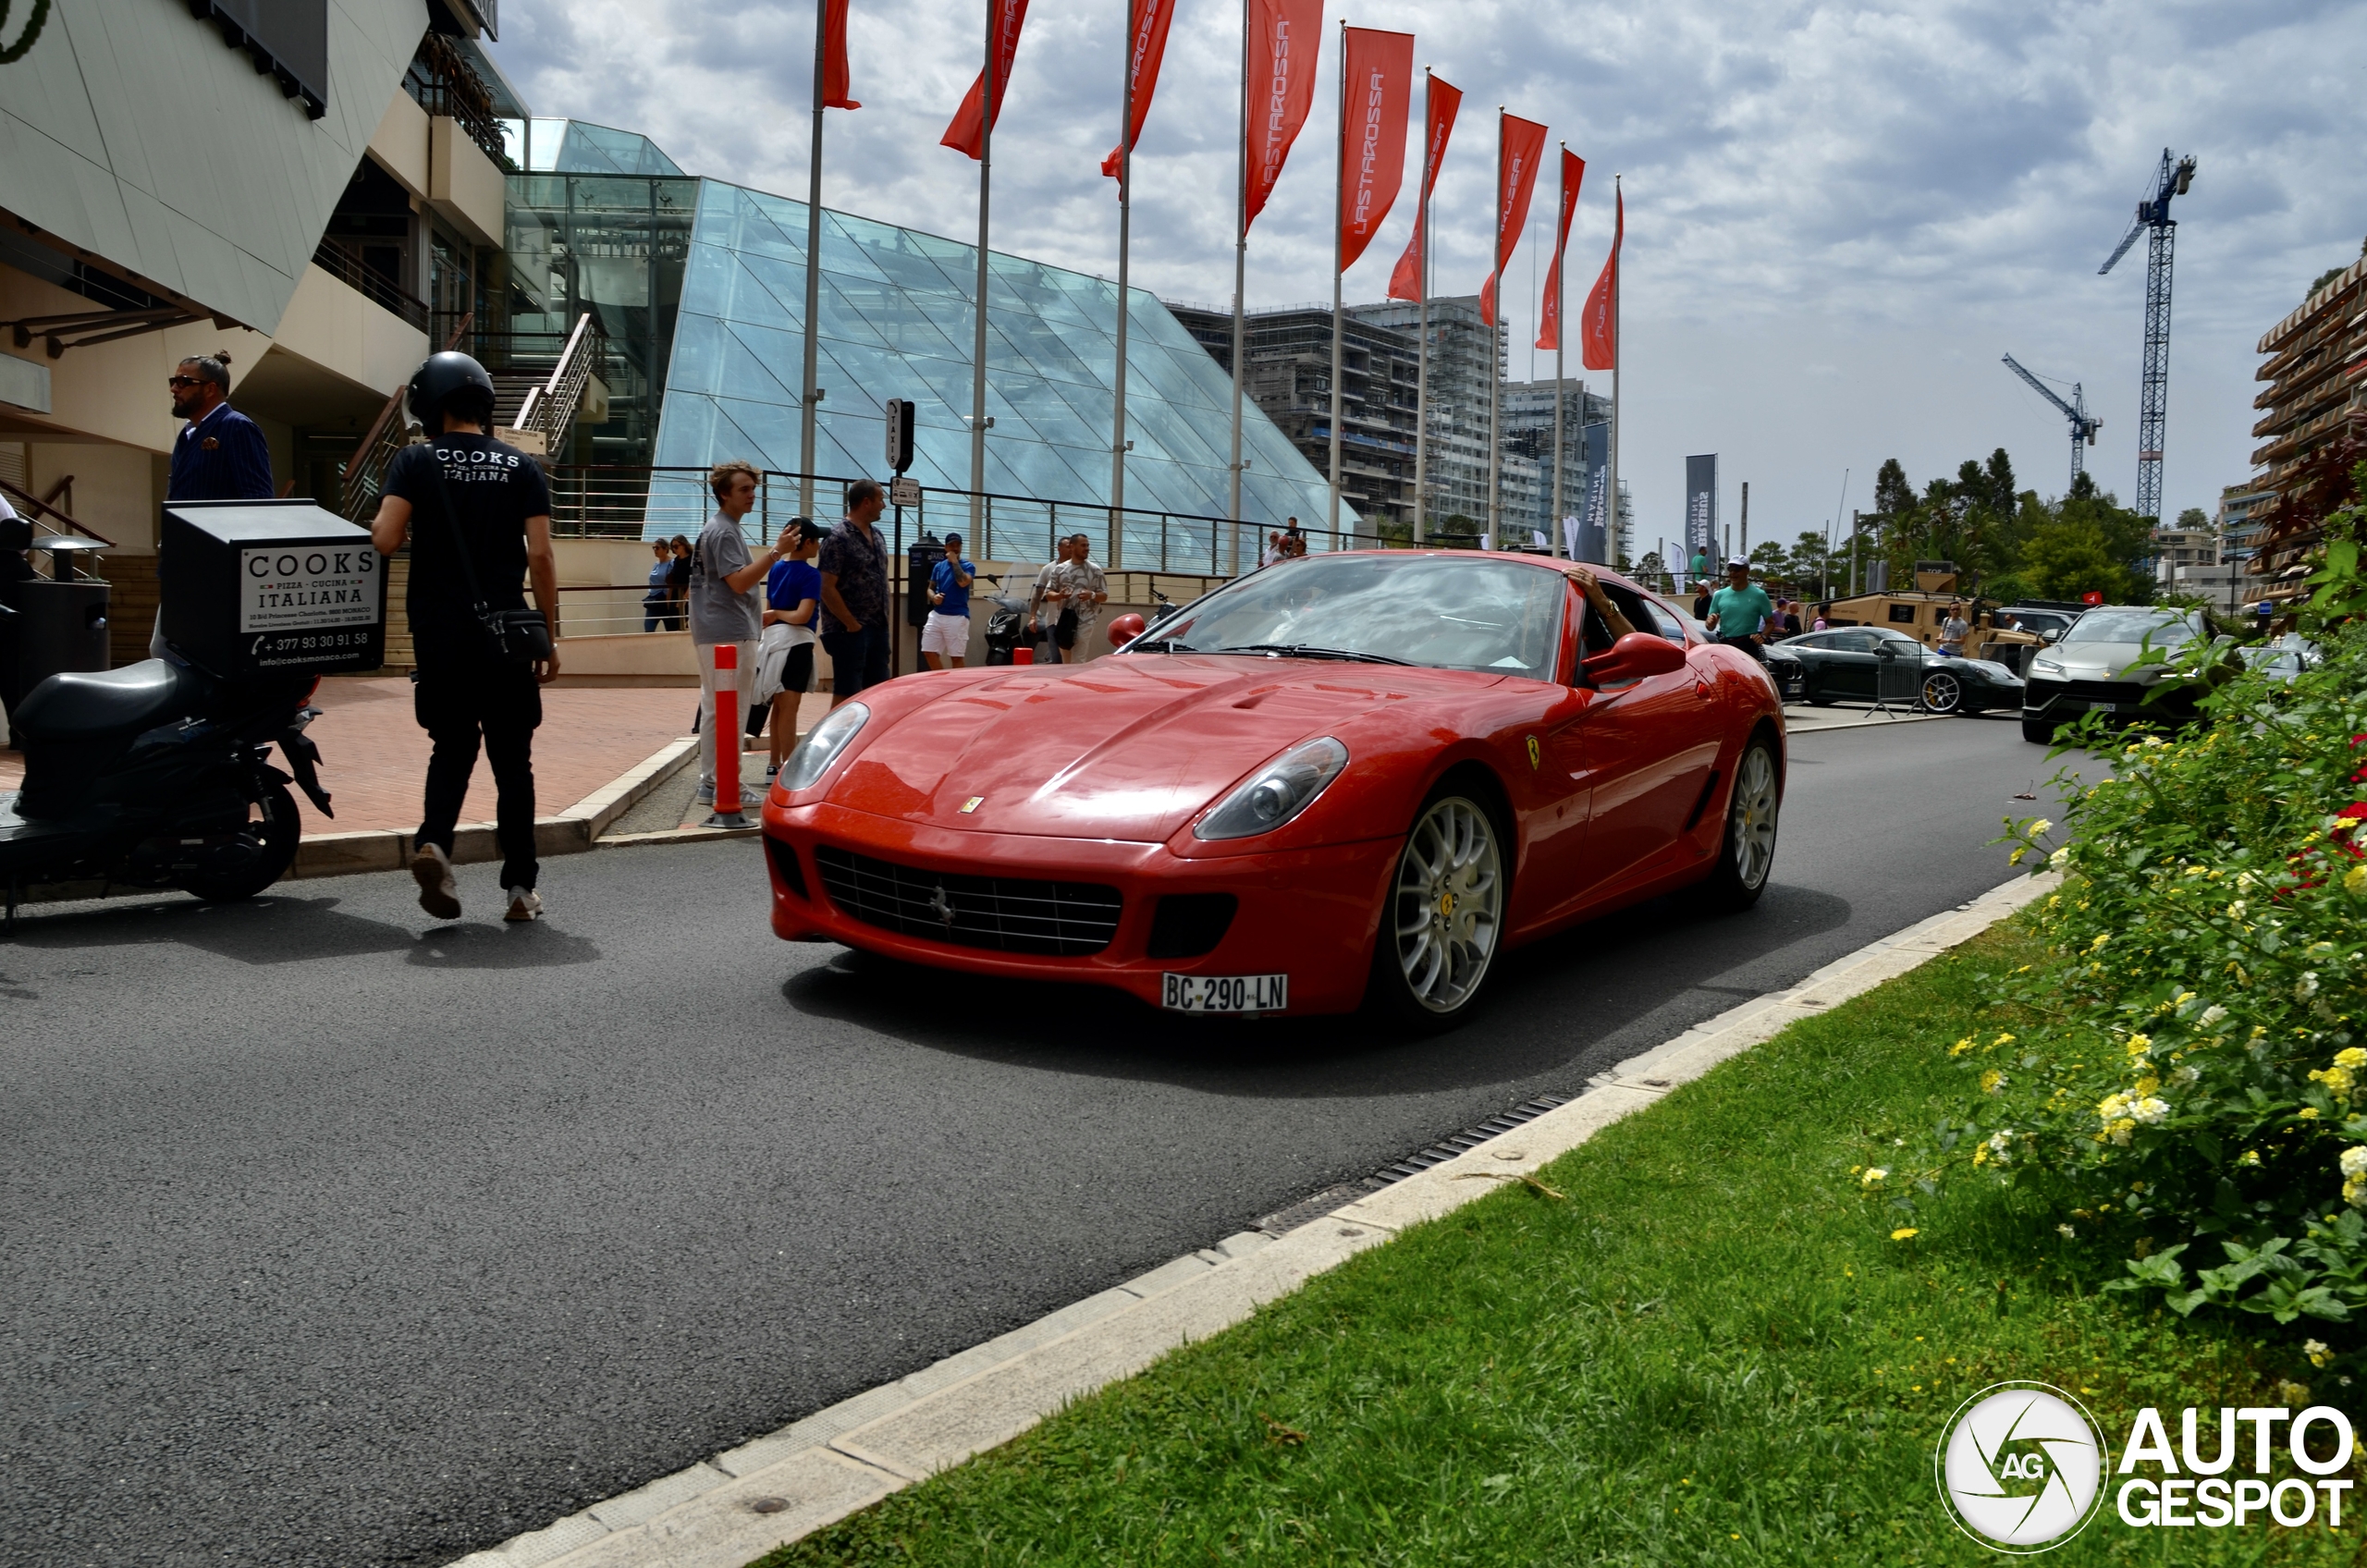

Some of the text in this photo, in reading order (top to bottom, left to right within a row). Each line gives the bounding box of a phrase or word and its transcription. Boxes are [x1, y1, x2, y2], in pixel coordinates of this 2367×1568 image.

[1354, 72, 1384, 235] L'ASTAROSSA
[435, 448, 520, 468] COOKS
[249, 551, 374, 578] COOKS
[276, 582, 303, 590] PIZZA
[312, 579, 348, 588] CUCINA
[259, 589, 362, 608] ITALIANA
[268, 611, 298, 619] Princesse
[342, 606, 372, 615] MONACO
[276, 638, 299, 651] 377
[301, 636, 316, 649] 93
[319, 635, 334, 647] 30
[337, 634, 350, 646] 91
[353, 632, 368, 644] 58
[260, 652, 360, 667] info@cooksmonaco.com
